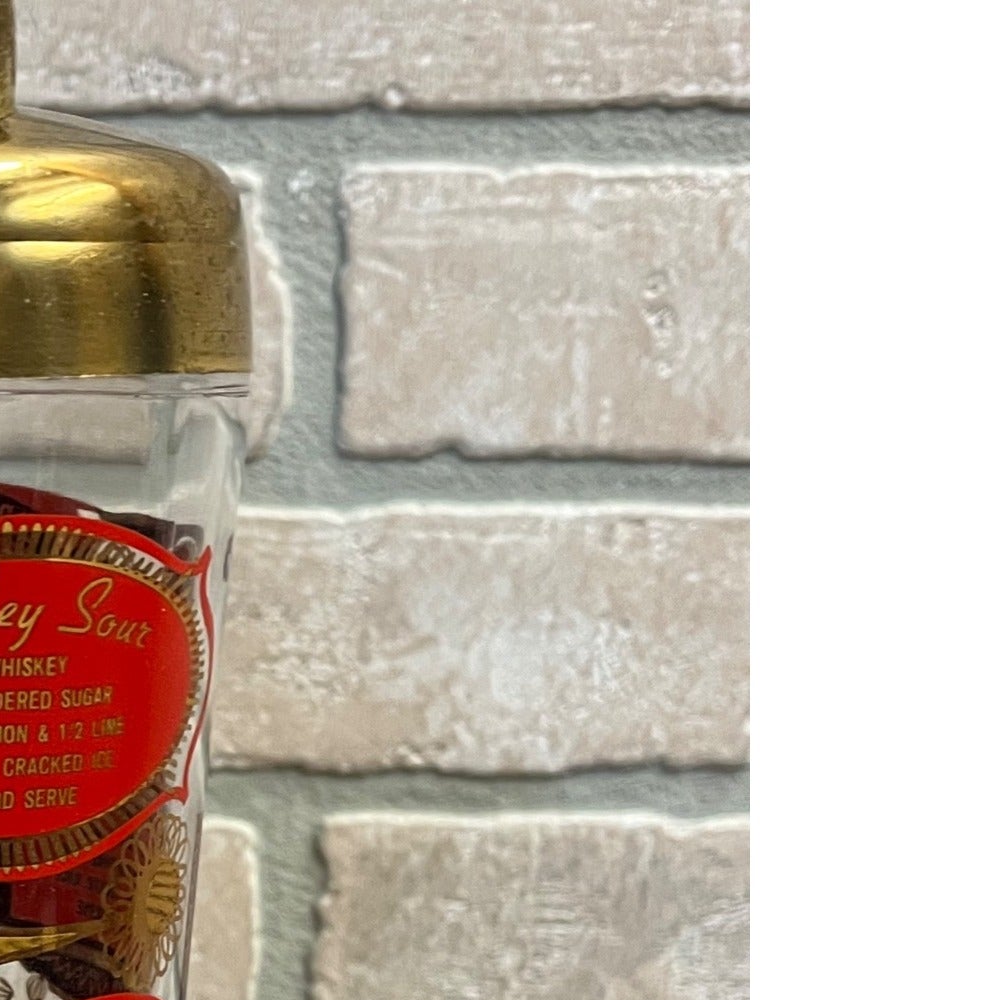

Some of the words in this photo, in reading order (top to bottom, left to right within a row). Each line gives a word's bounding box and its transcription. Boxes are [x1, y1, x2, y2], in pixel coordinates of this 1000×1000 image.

[58, 578, 152, 648] Sour
[60, 685, 114, 709] SUGAR
[38, 724, 49, 743] &
[2, 753, 83, 777] CRACKED
[23, 786, 79, 809] SERVE
